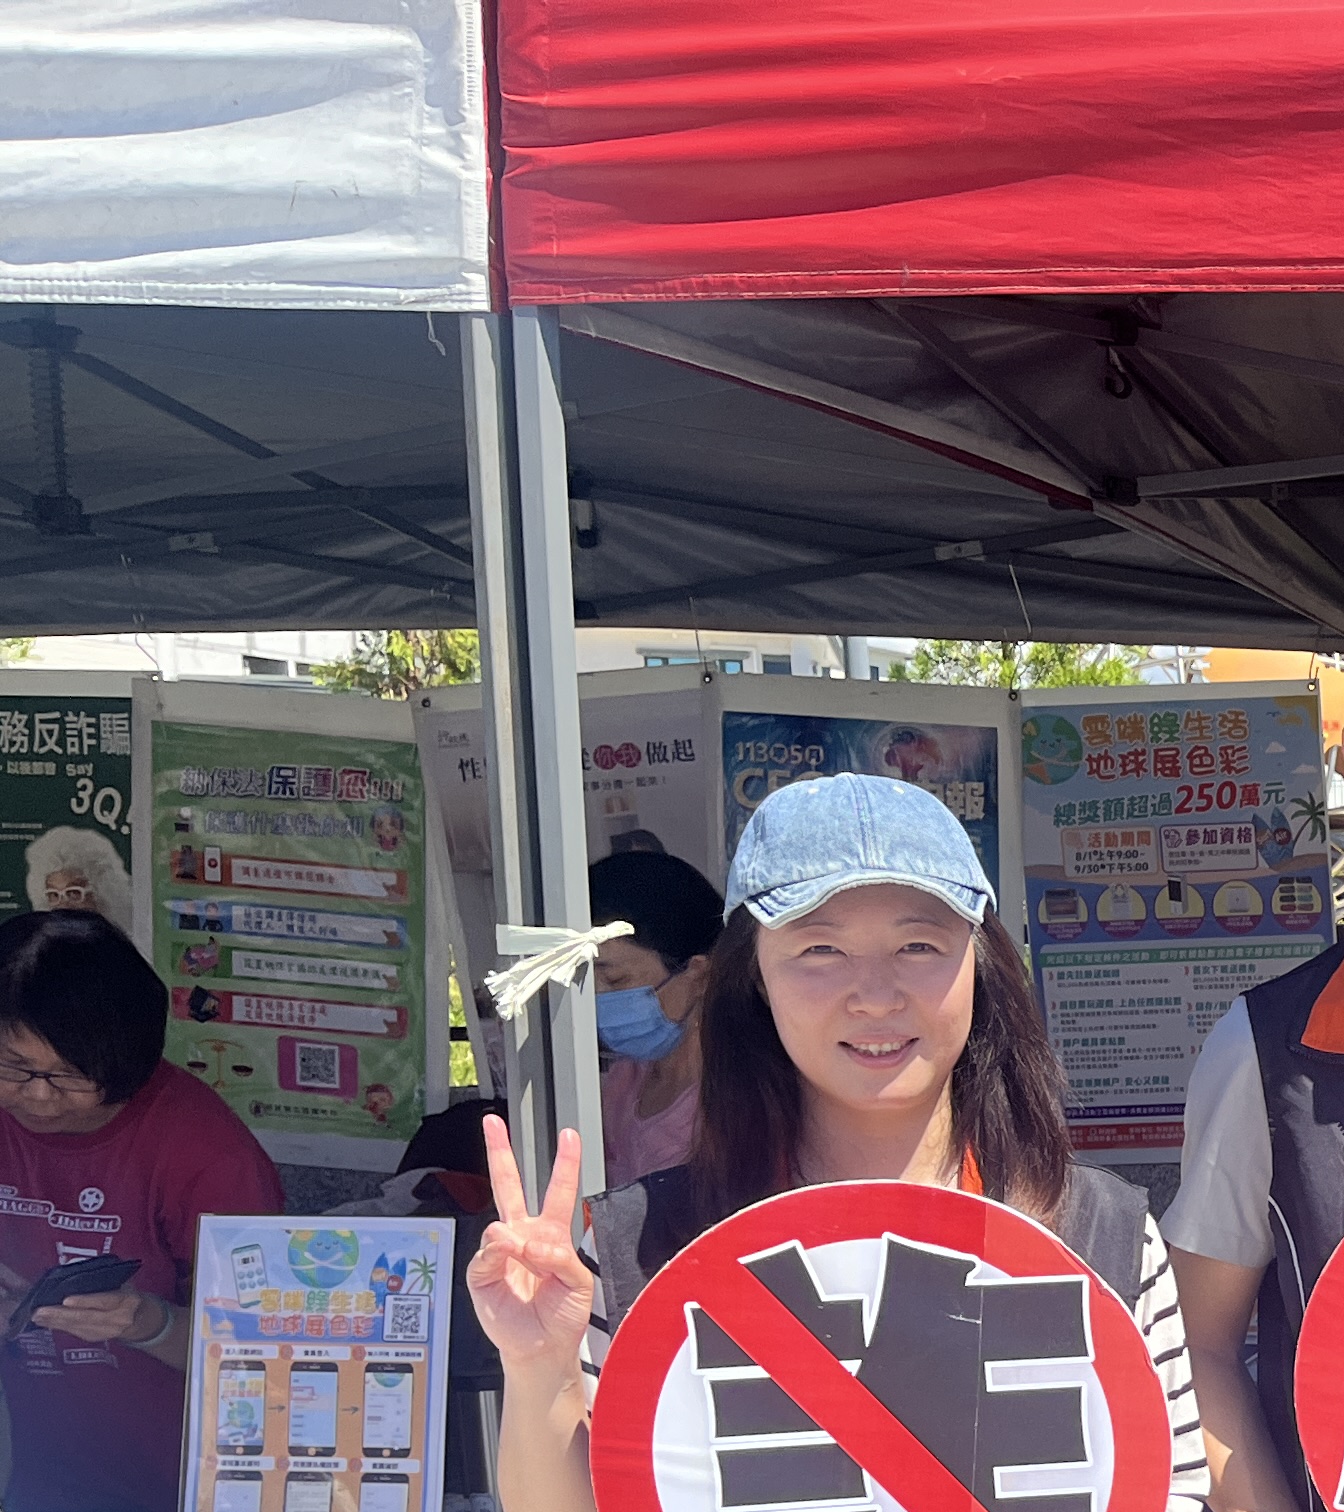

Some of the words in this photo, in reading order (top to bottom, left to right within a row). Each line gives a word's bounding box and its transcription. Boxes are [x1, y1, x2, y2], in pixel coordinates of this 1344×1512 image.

[1081, 709, 1249, 747] 雲端綠生活
[65, 762, 93, 776] Say
[458, 757, 486, 782] 性
[1085, 745, 1250, 780] 地球展色彩
